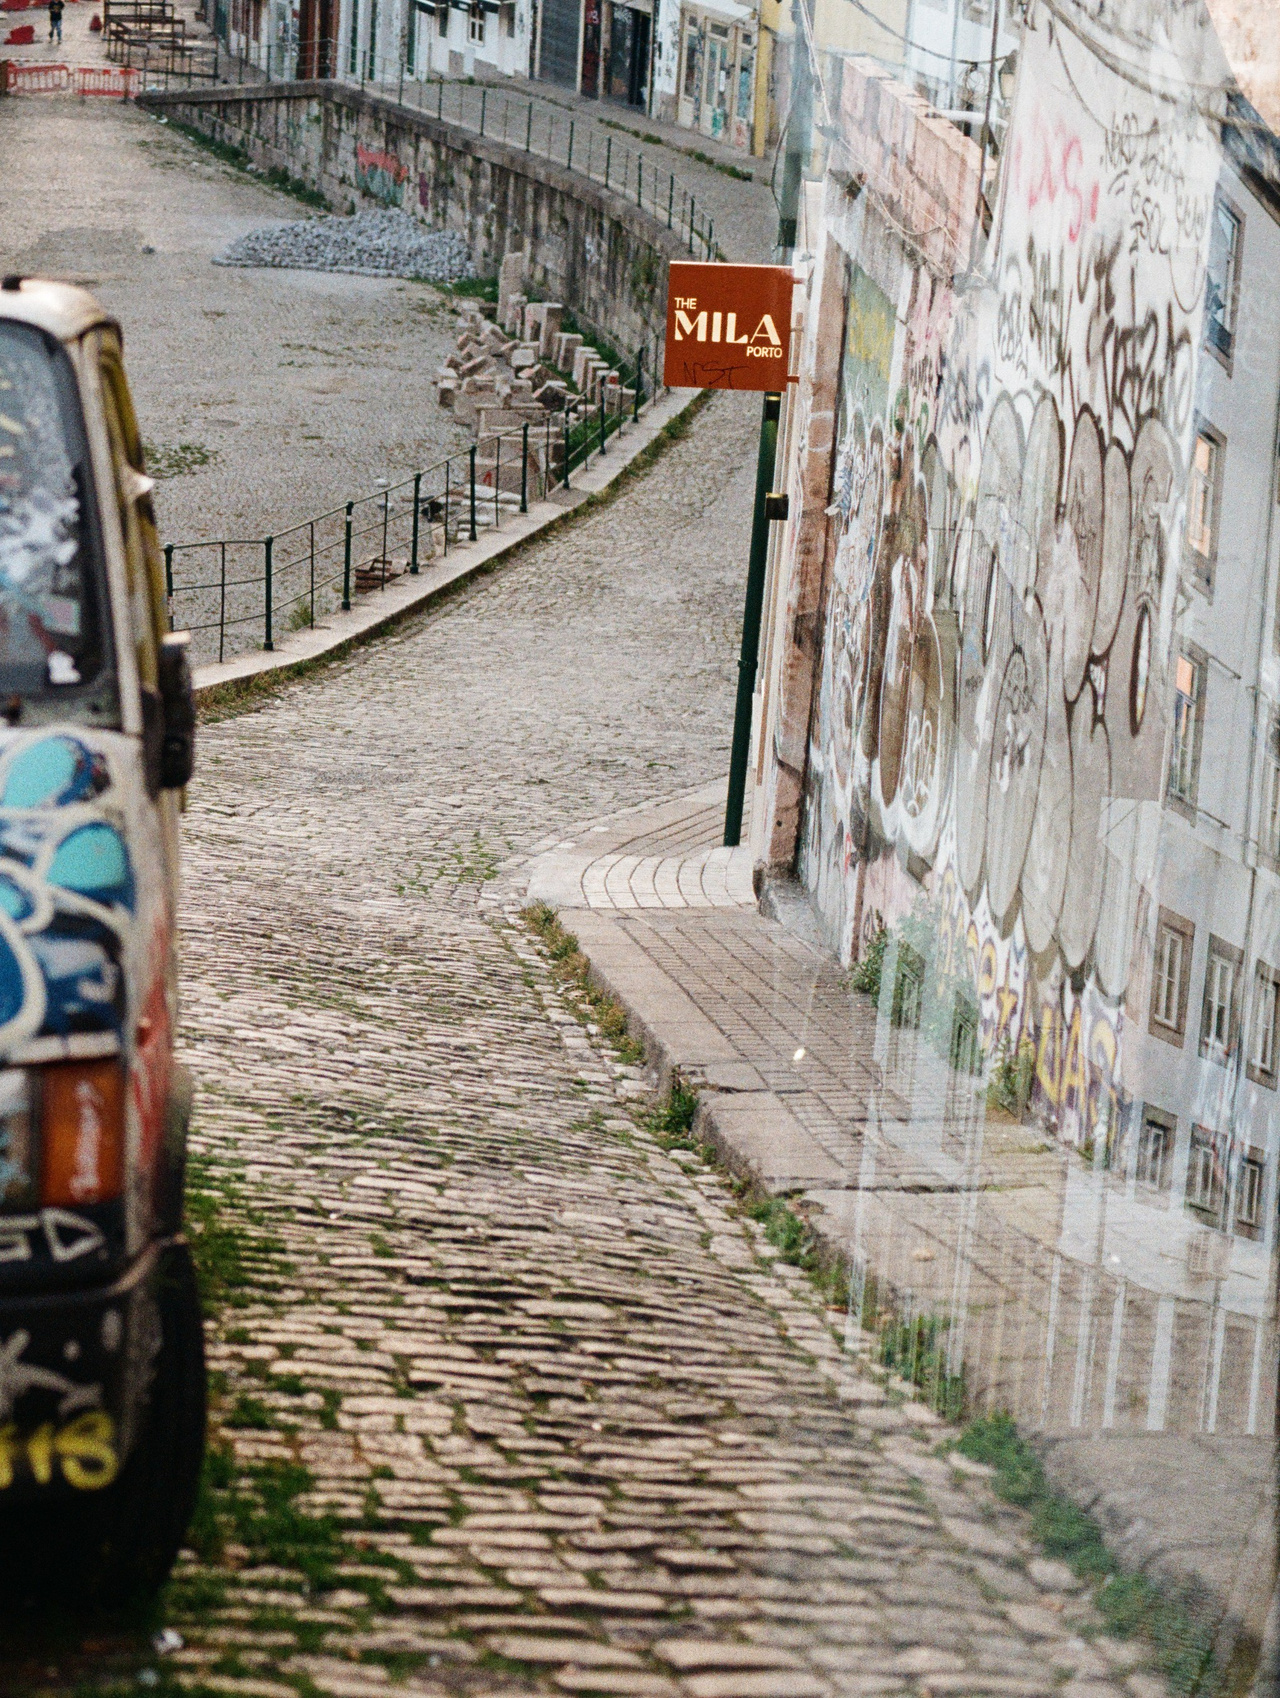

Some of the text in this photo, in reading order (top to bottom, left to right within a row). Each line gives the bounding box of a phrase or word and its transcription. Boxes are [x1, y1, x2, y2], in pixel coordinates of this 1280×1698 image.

[674, 297, 697, 309] THE
[674, 310, 781, 345] MILA
[746, 346, 783, 358] PORTO
